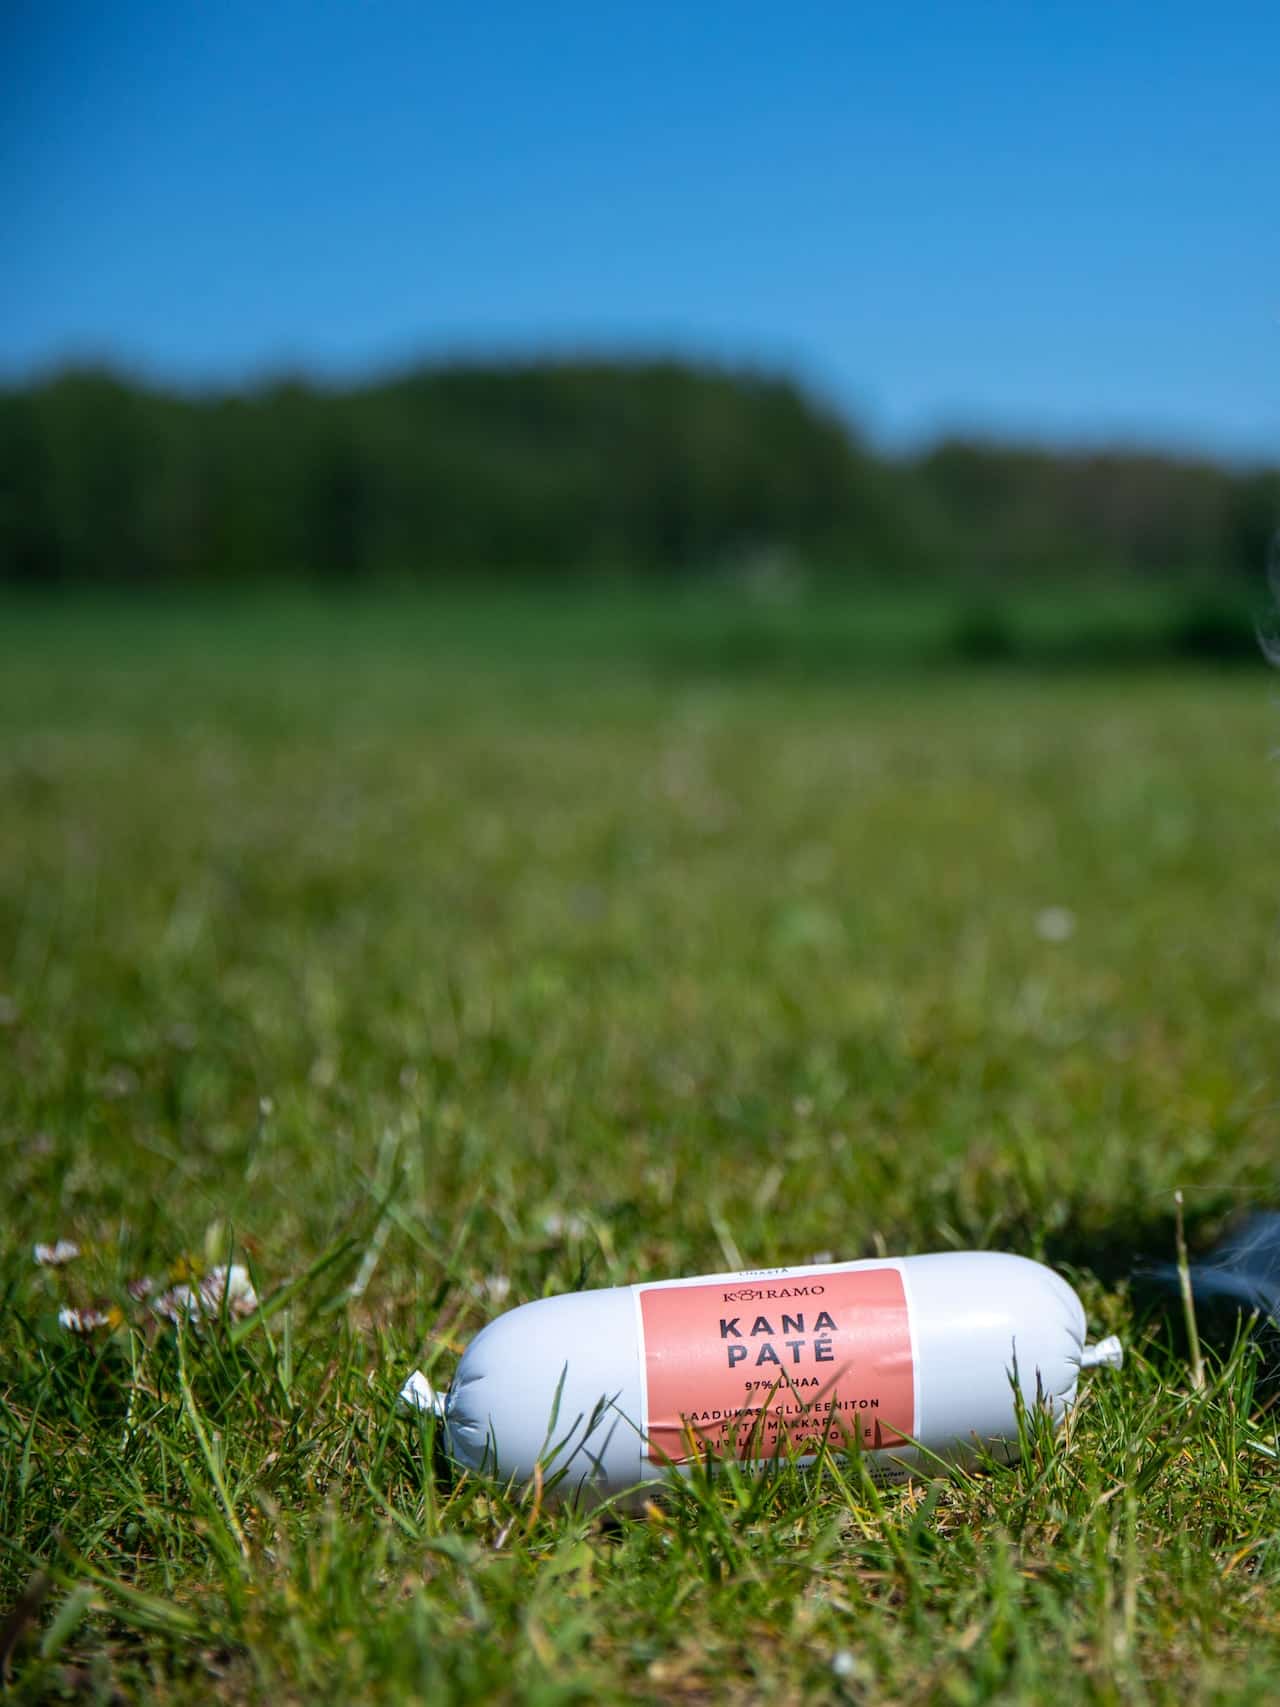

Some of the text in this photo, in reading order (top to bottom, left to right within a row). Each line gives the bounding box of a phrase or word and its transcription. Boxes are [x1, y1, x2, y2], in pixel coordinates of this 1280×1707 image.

[719, 1311, 838, 1338] KANA
[727, 1333, 835, 1368] PATÉ
[745, 1377, 820, 1391] 97% LIHAA
